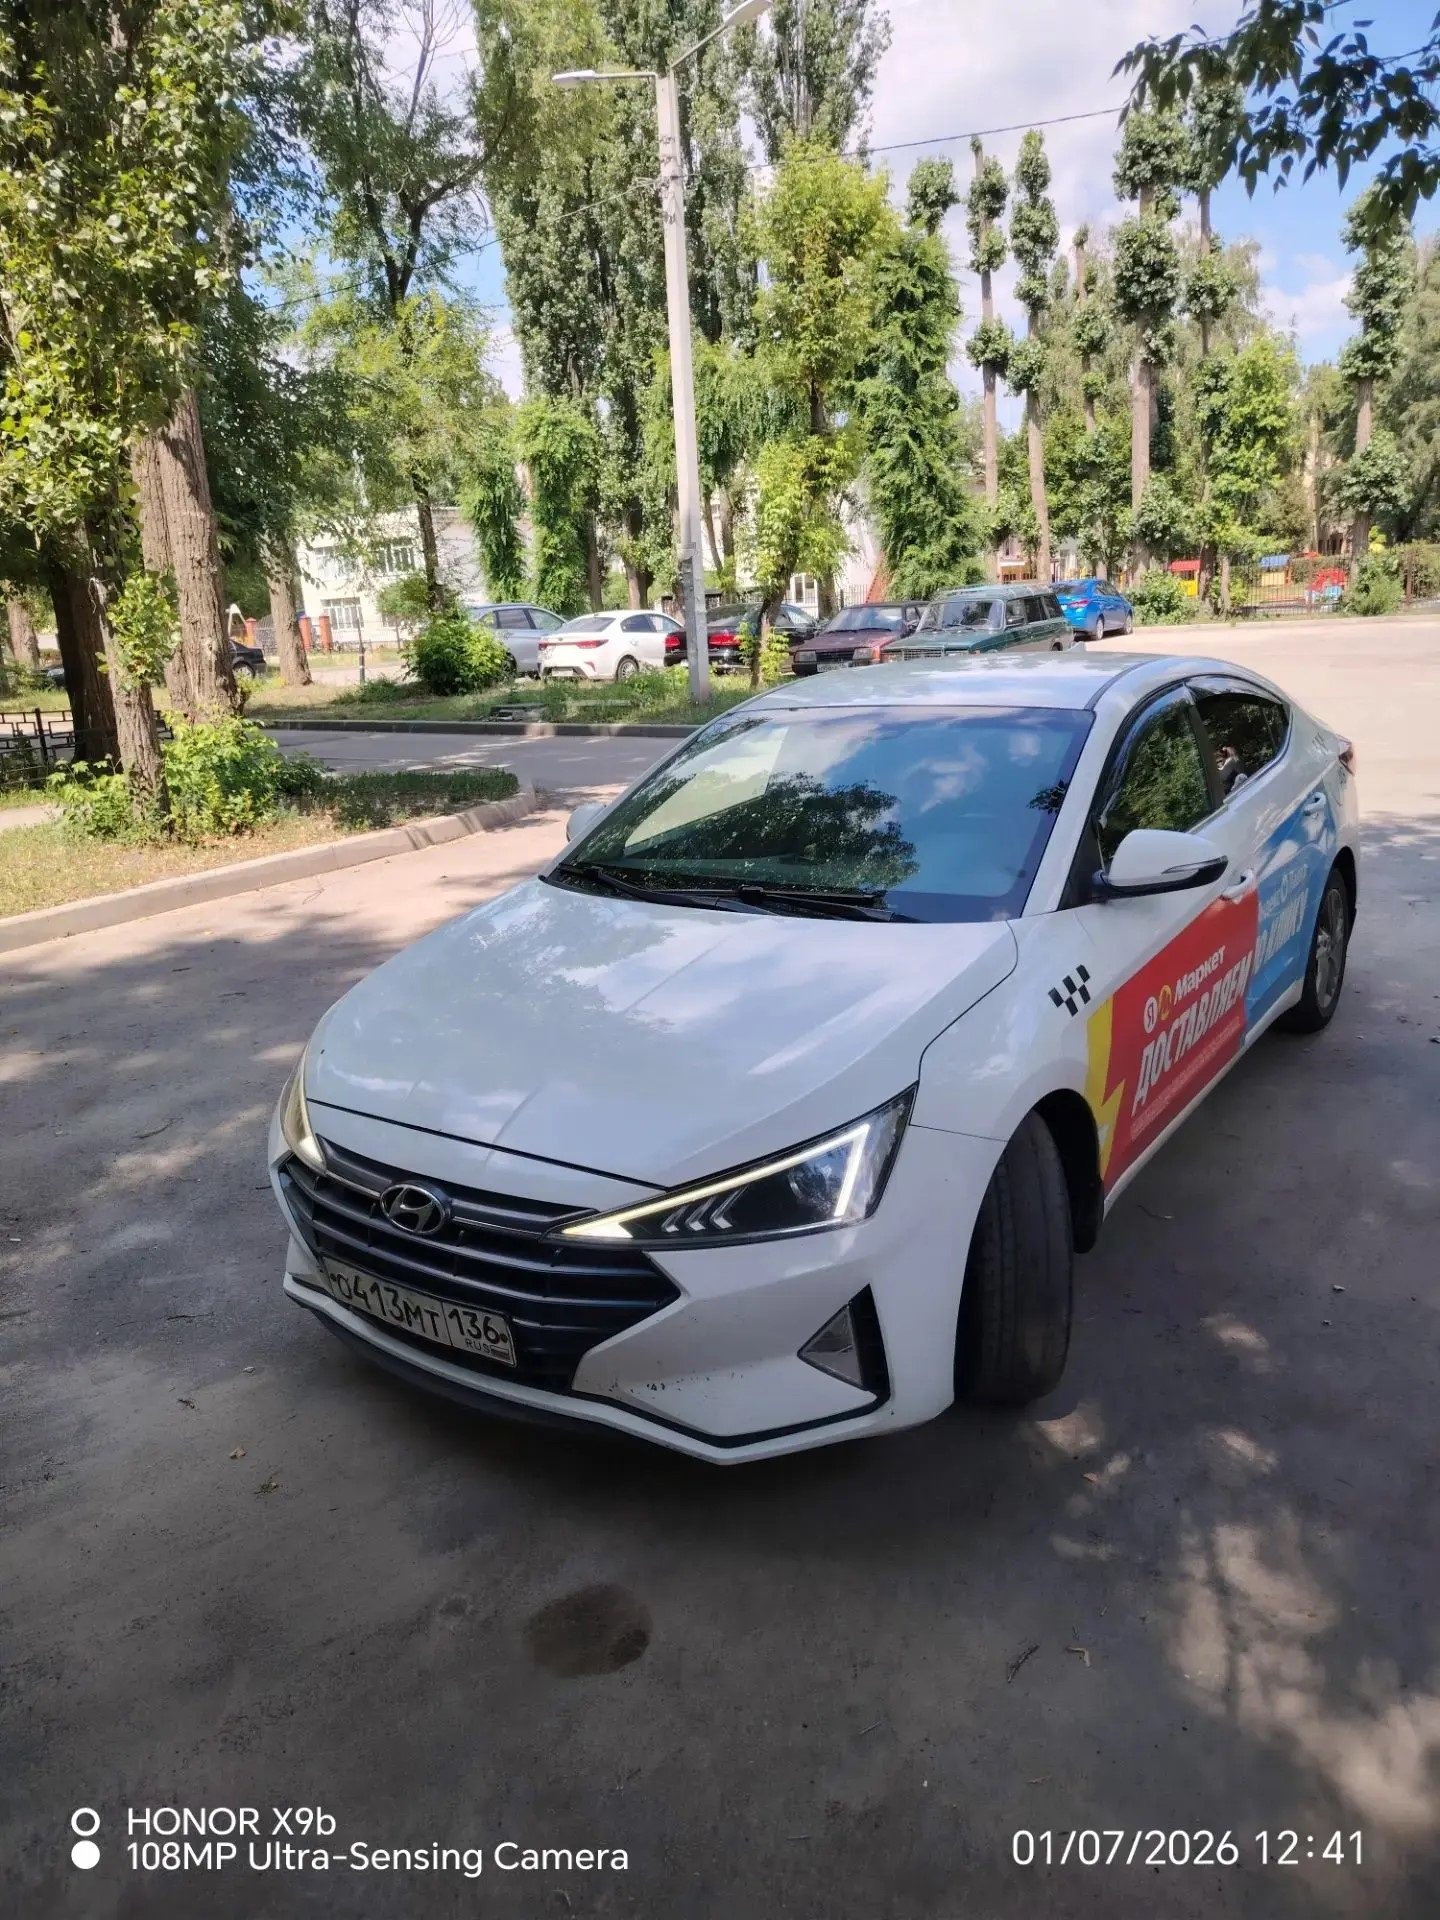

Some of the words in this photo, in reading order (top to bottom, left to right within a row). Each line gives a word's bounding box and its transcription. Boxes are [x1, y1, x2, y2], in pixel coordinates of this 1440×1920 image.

[1173, 945, 1226, 1006] Маркет
[1131, 951, 1253, 1118] ДОСТАВЛЯЕМ
[449, 1309, 500, 1345] 136
[465, 1338, 491, 1354] RUS
